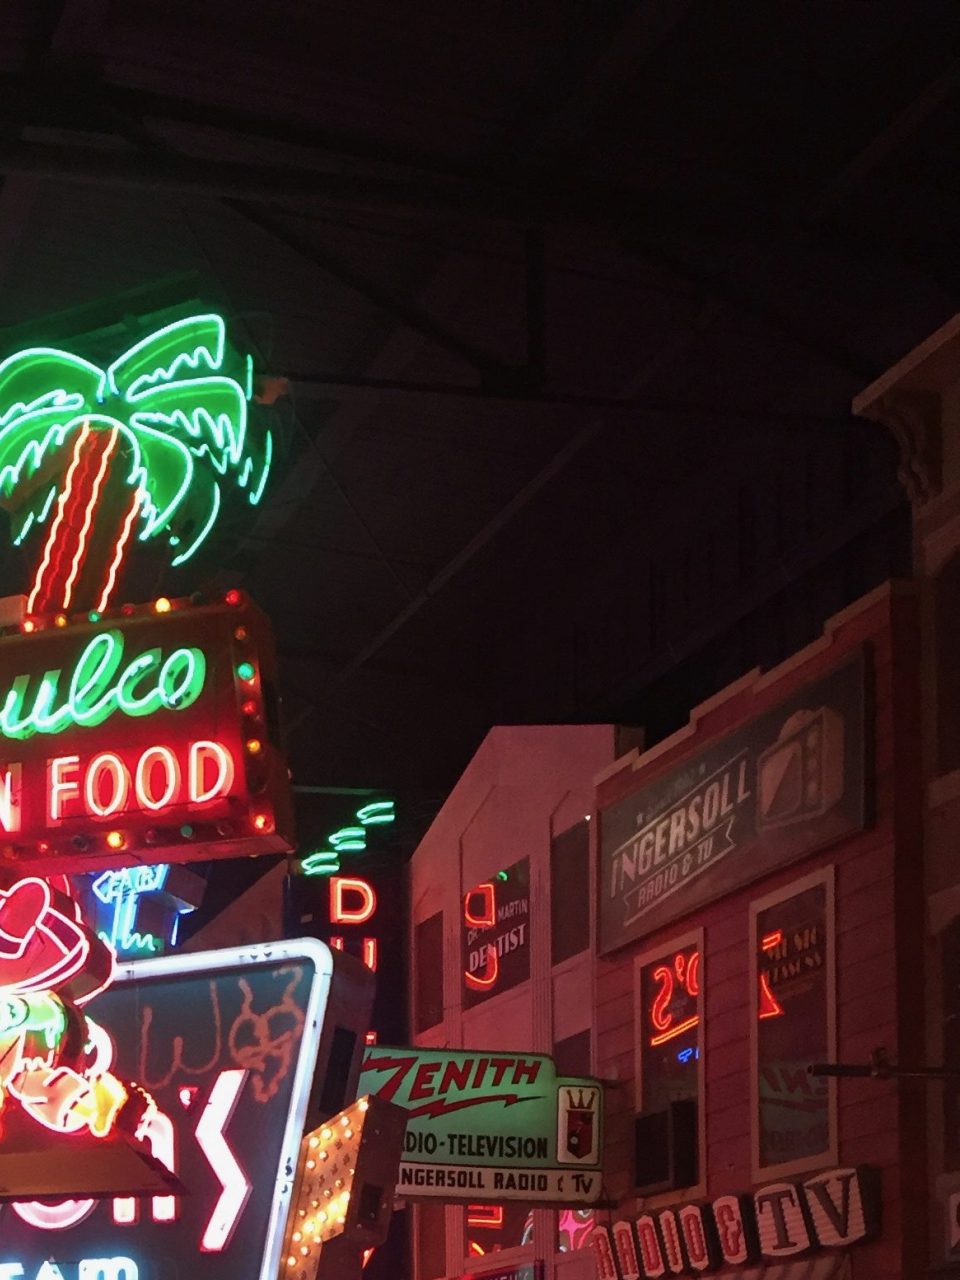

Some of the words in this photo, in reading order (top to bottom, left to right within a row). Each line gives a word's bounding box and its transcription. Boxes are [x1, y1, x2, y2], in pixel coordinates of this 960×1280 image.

[46, 740, 235, 827] FOOD
[611, 760, 751, 898] INGERSOLL
[638, 864, 678, 907] RADIO
[497, 899, 528, 922] MARTIN
[360, 1054, 542, 1102] ZENITH
[403, 1131, 549, 1159] DIO-TELEVISION
[401, 1167, 485, 1190] NGERSOLL
[494, 1171, 548, 1192] RADIO
[715, 1200, 743, 1260] &
[757, 1171, 858, 1251] TV
